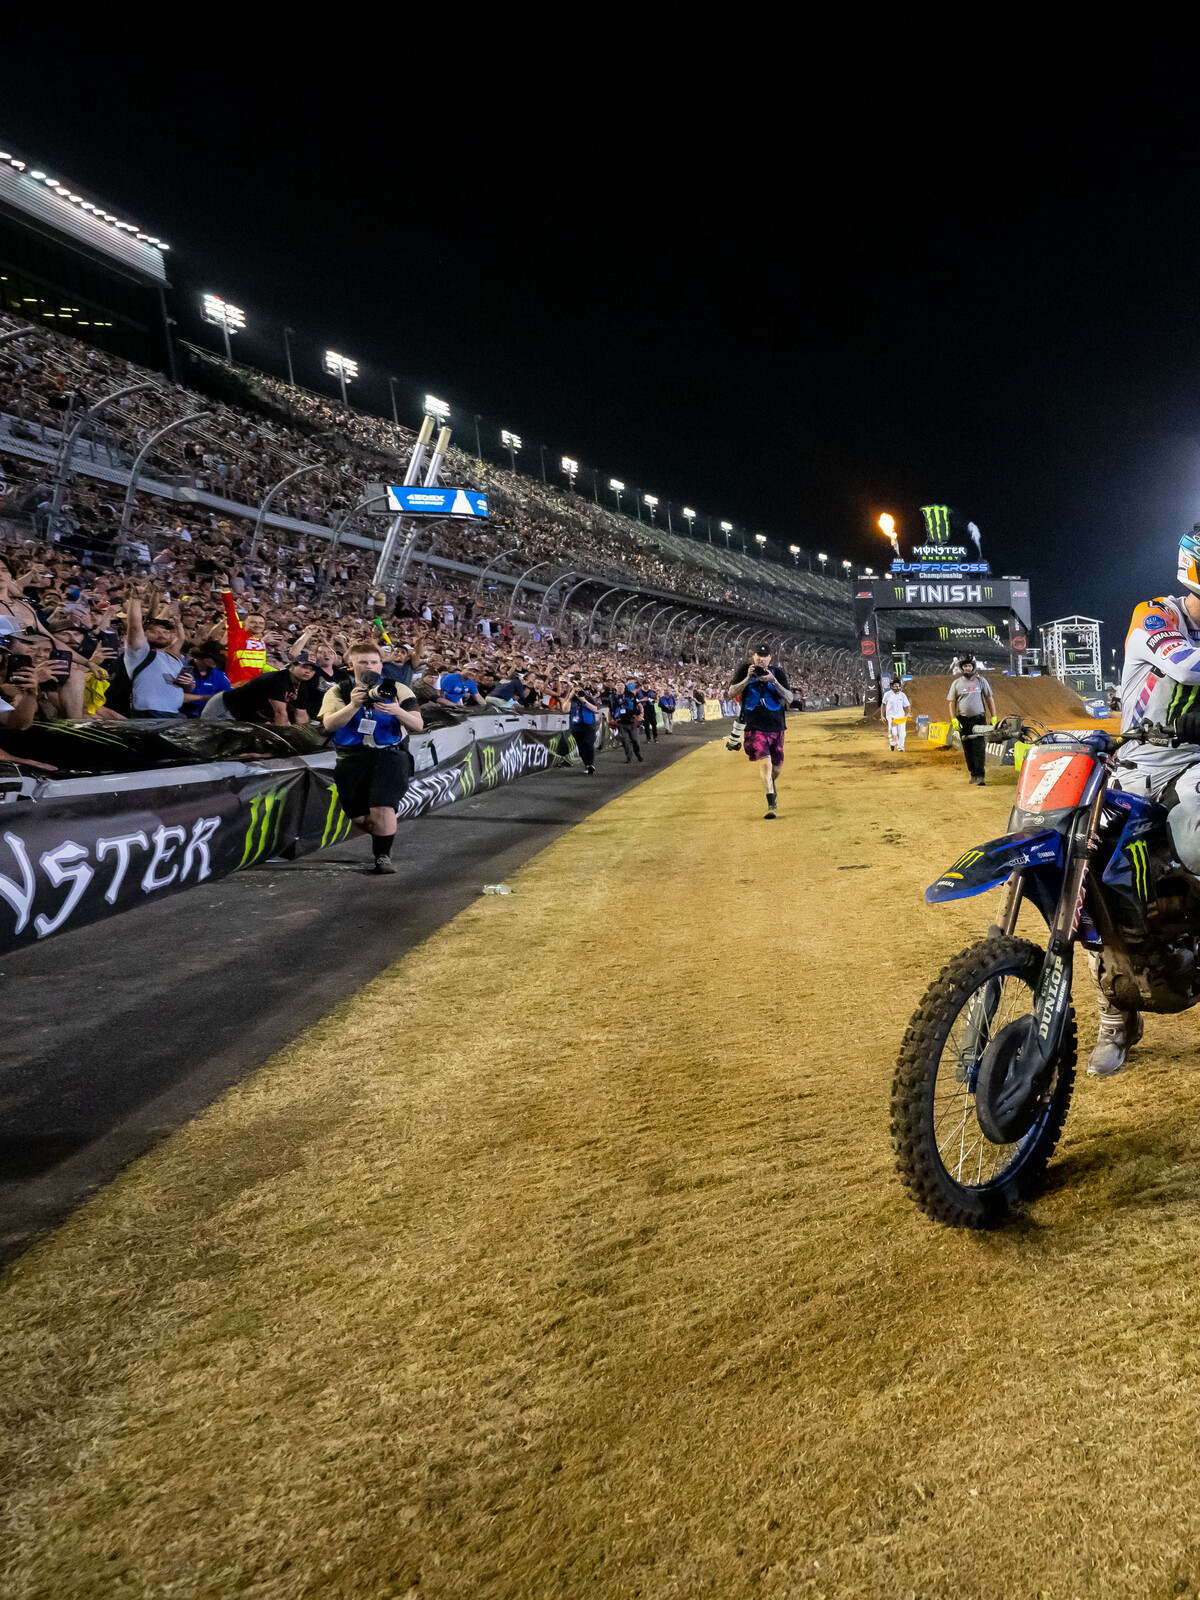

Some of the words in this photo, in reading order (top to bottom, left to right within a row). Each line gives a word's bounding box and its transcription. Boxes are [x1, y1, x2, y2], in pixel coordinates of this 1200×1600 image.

[913, 545, 967, 556] MONSTER
[890, 563, 989, 572] SUPERCROSS
[918, 572, 963, 580] Championship
[905, 584, 982, 603] FINISH
[950, 627, 986, 635] MONSTER
[1162, 641, 1183, 657] BELL
[500, 739, 549, 781] MONSTER
[1026, 755, 1074, 806] 1
[1038, 955, 1065, 1041] DUNLOP
